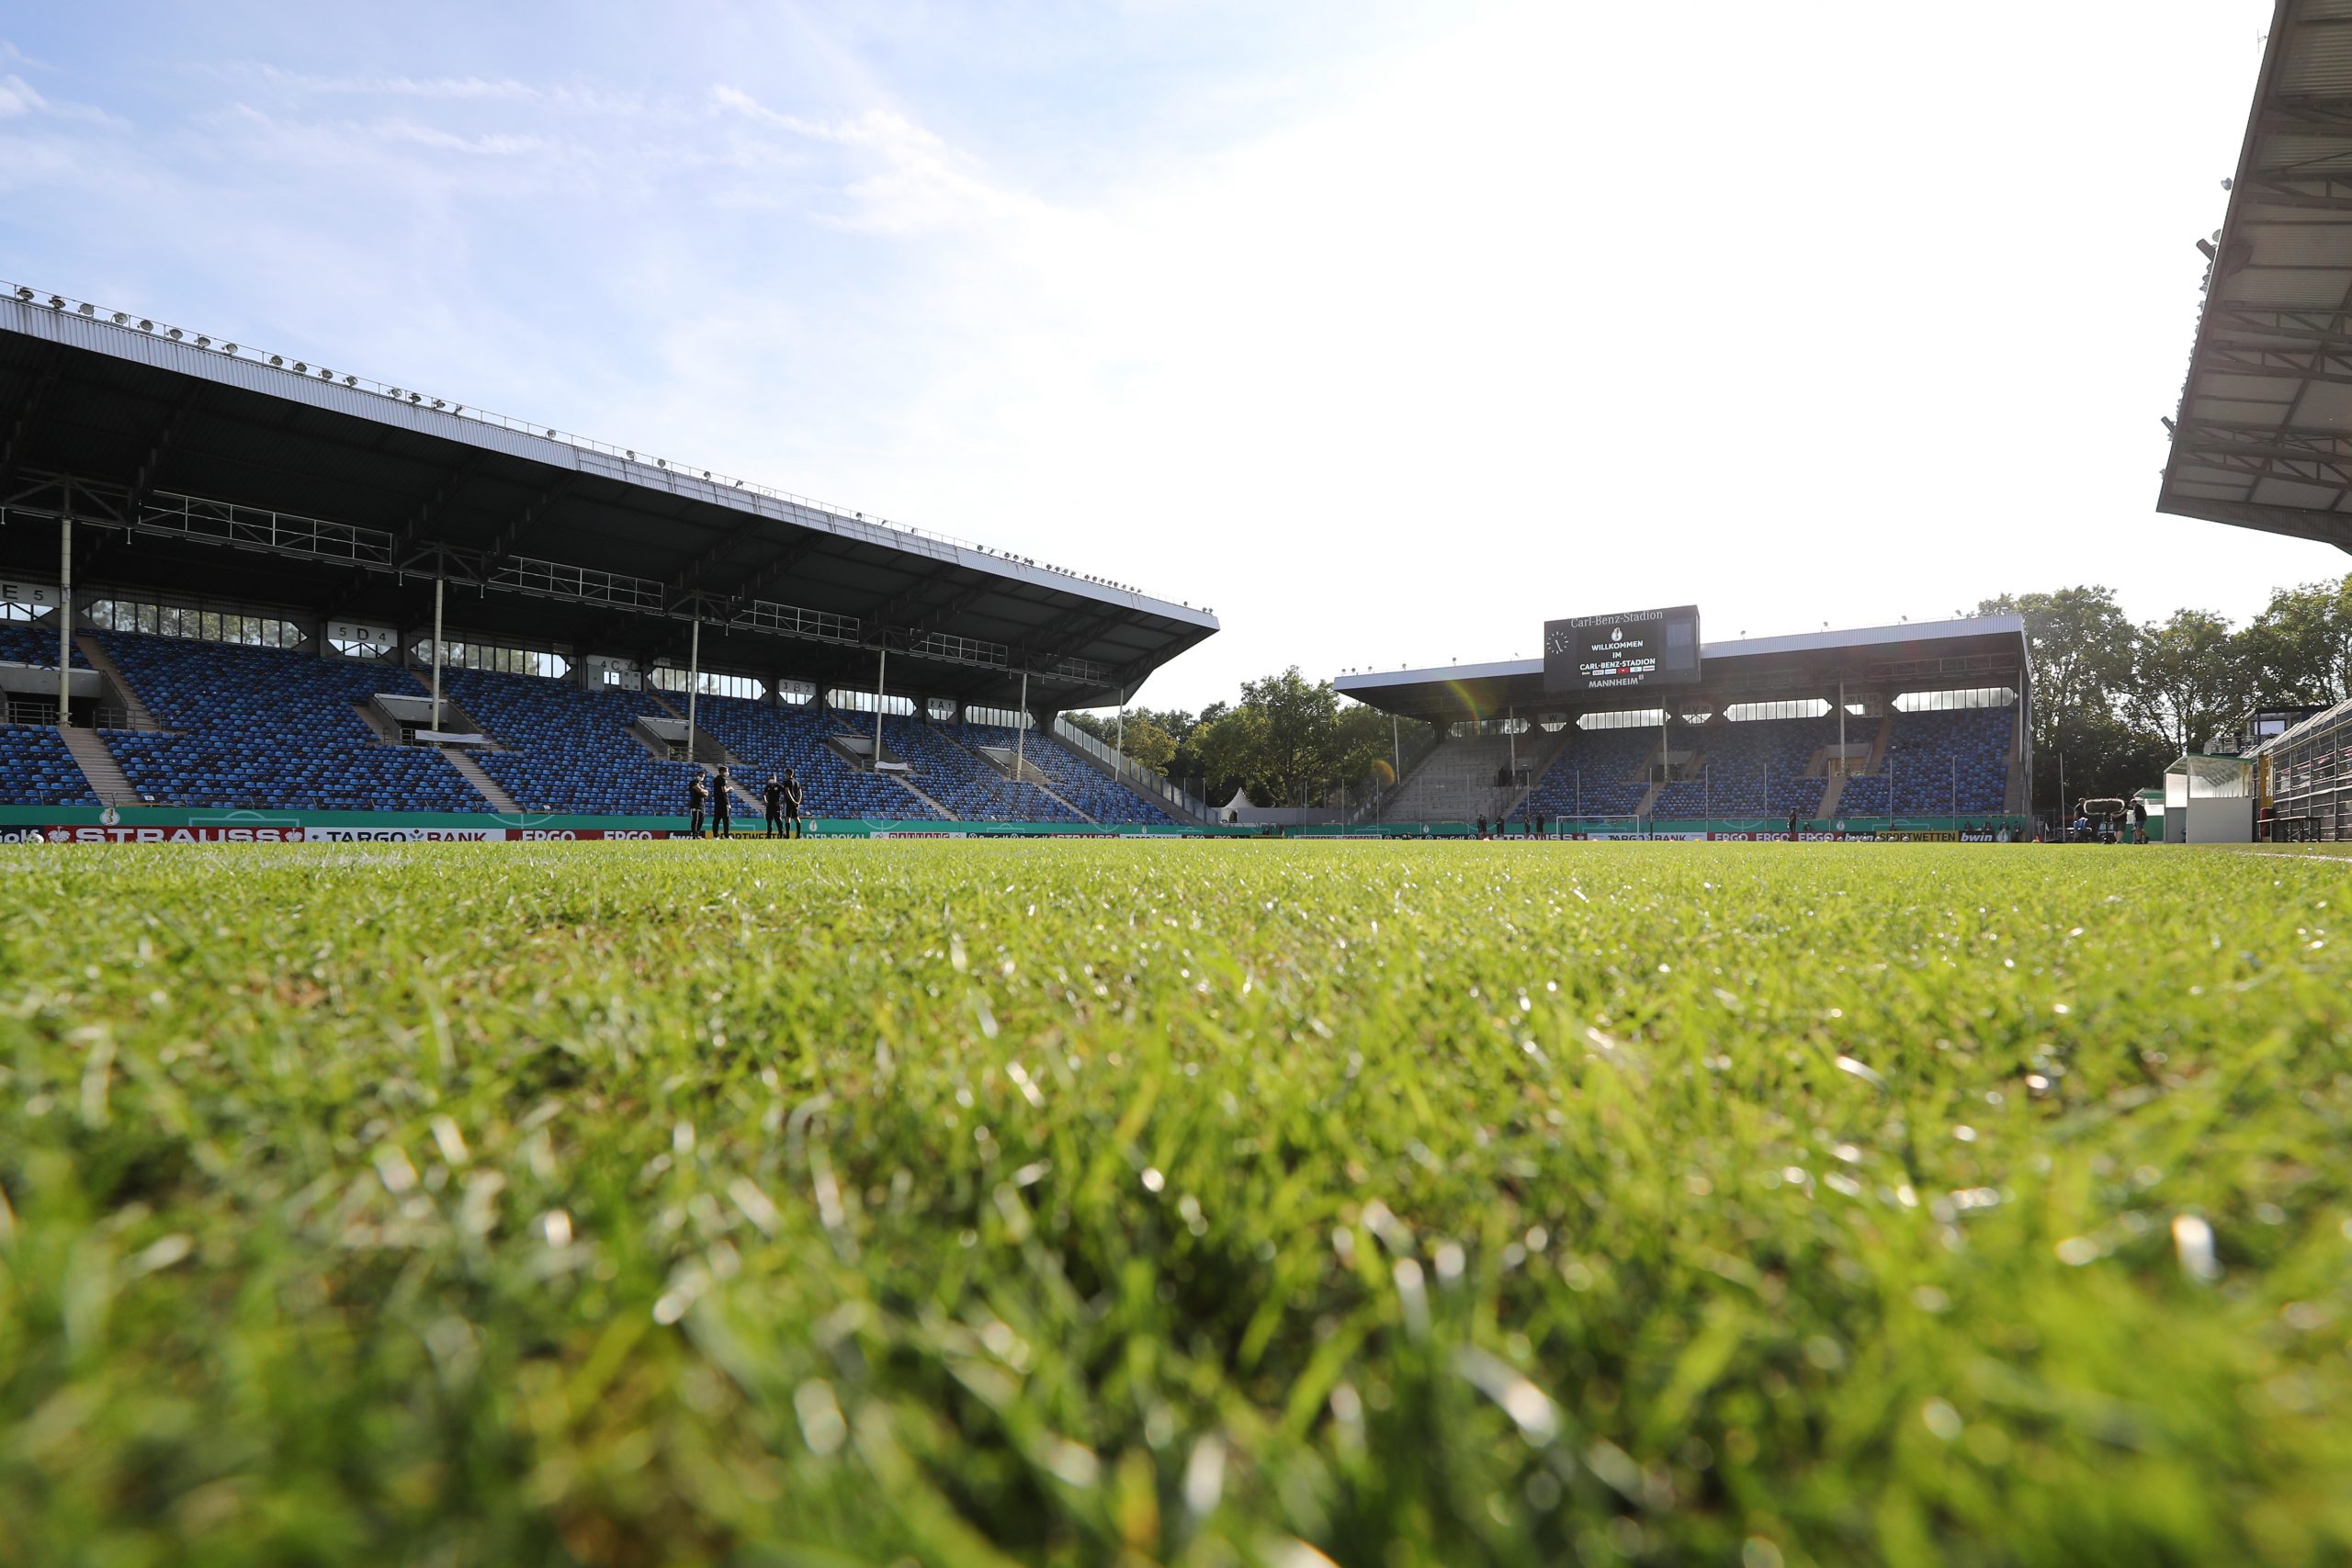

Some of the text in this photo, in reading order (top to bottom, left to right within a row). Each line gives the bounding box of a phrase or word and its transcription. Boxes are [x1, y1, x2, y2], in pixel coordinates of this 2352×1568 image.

[2, 583, 44, 601] E 5
[1571, 611, 1663, 628] Carl-Benz-Stadion
[339, 627, 387, 642] 5 D 4
[1591, 640, 1644, 651] WILLKOMMEN
[611, 660, 620, 671] C
[1579, 658, 1656, 671] CARL-BENZ-STADION
[1589, 677, 1638, 688] MANNHEIM
[938, 700, 944, 709] A
[75, 828, 280, 843] STRAUSS
[326, 831, 487, 842] TARGO BANK
[521, 830, 576, 840] ERGO
[604, 830, 653, 840] ERGO
[1714, 833, 1748, 841] ERGO
[1756, 833, 1790, 841] ERGO
[1798, 832, 1834, 841] ERGO
[1961, 832, 1993, 842] bwin
